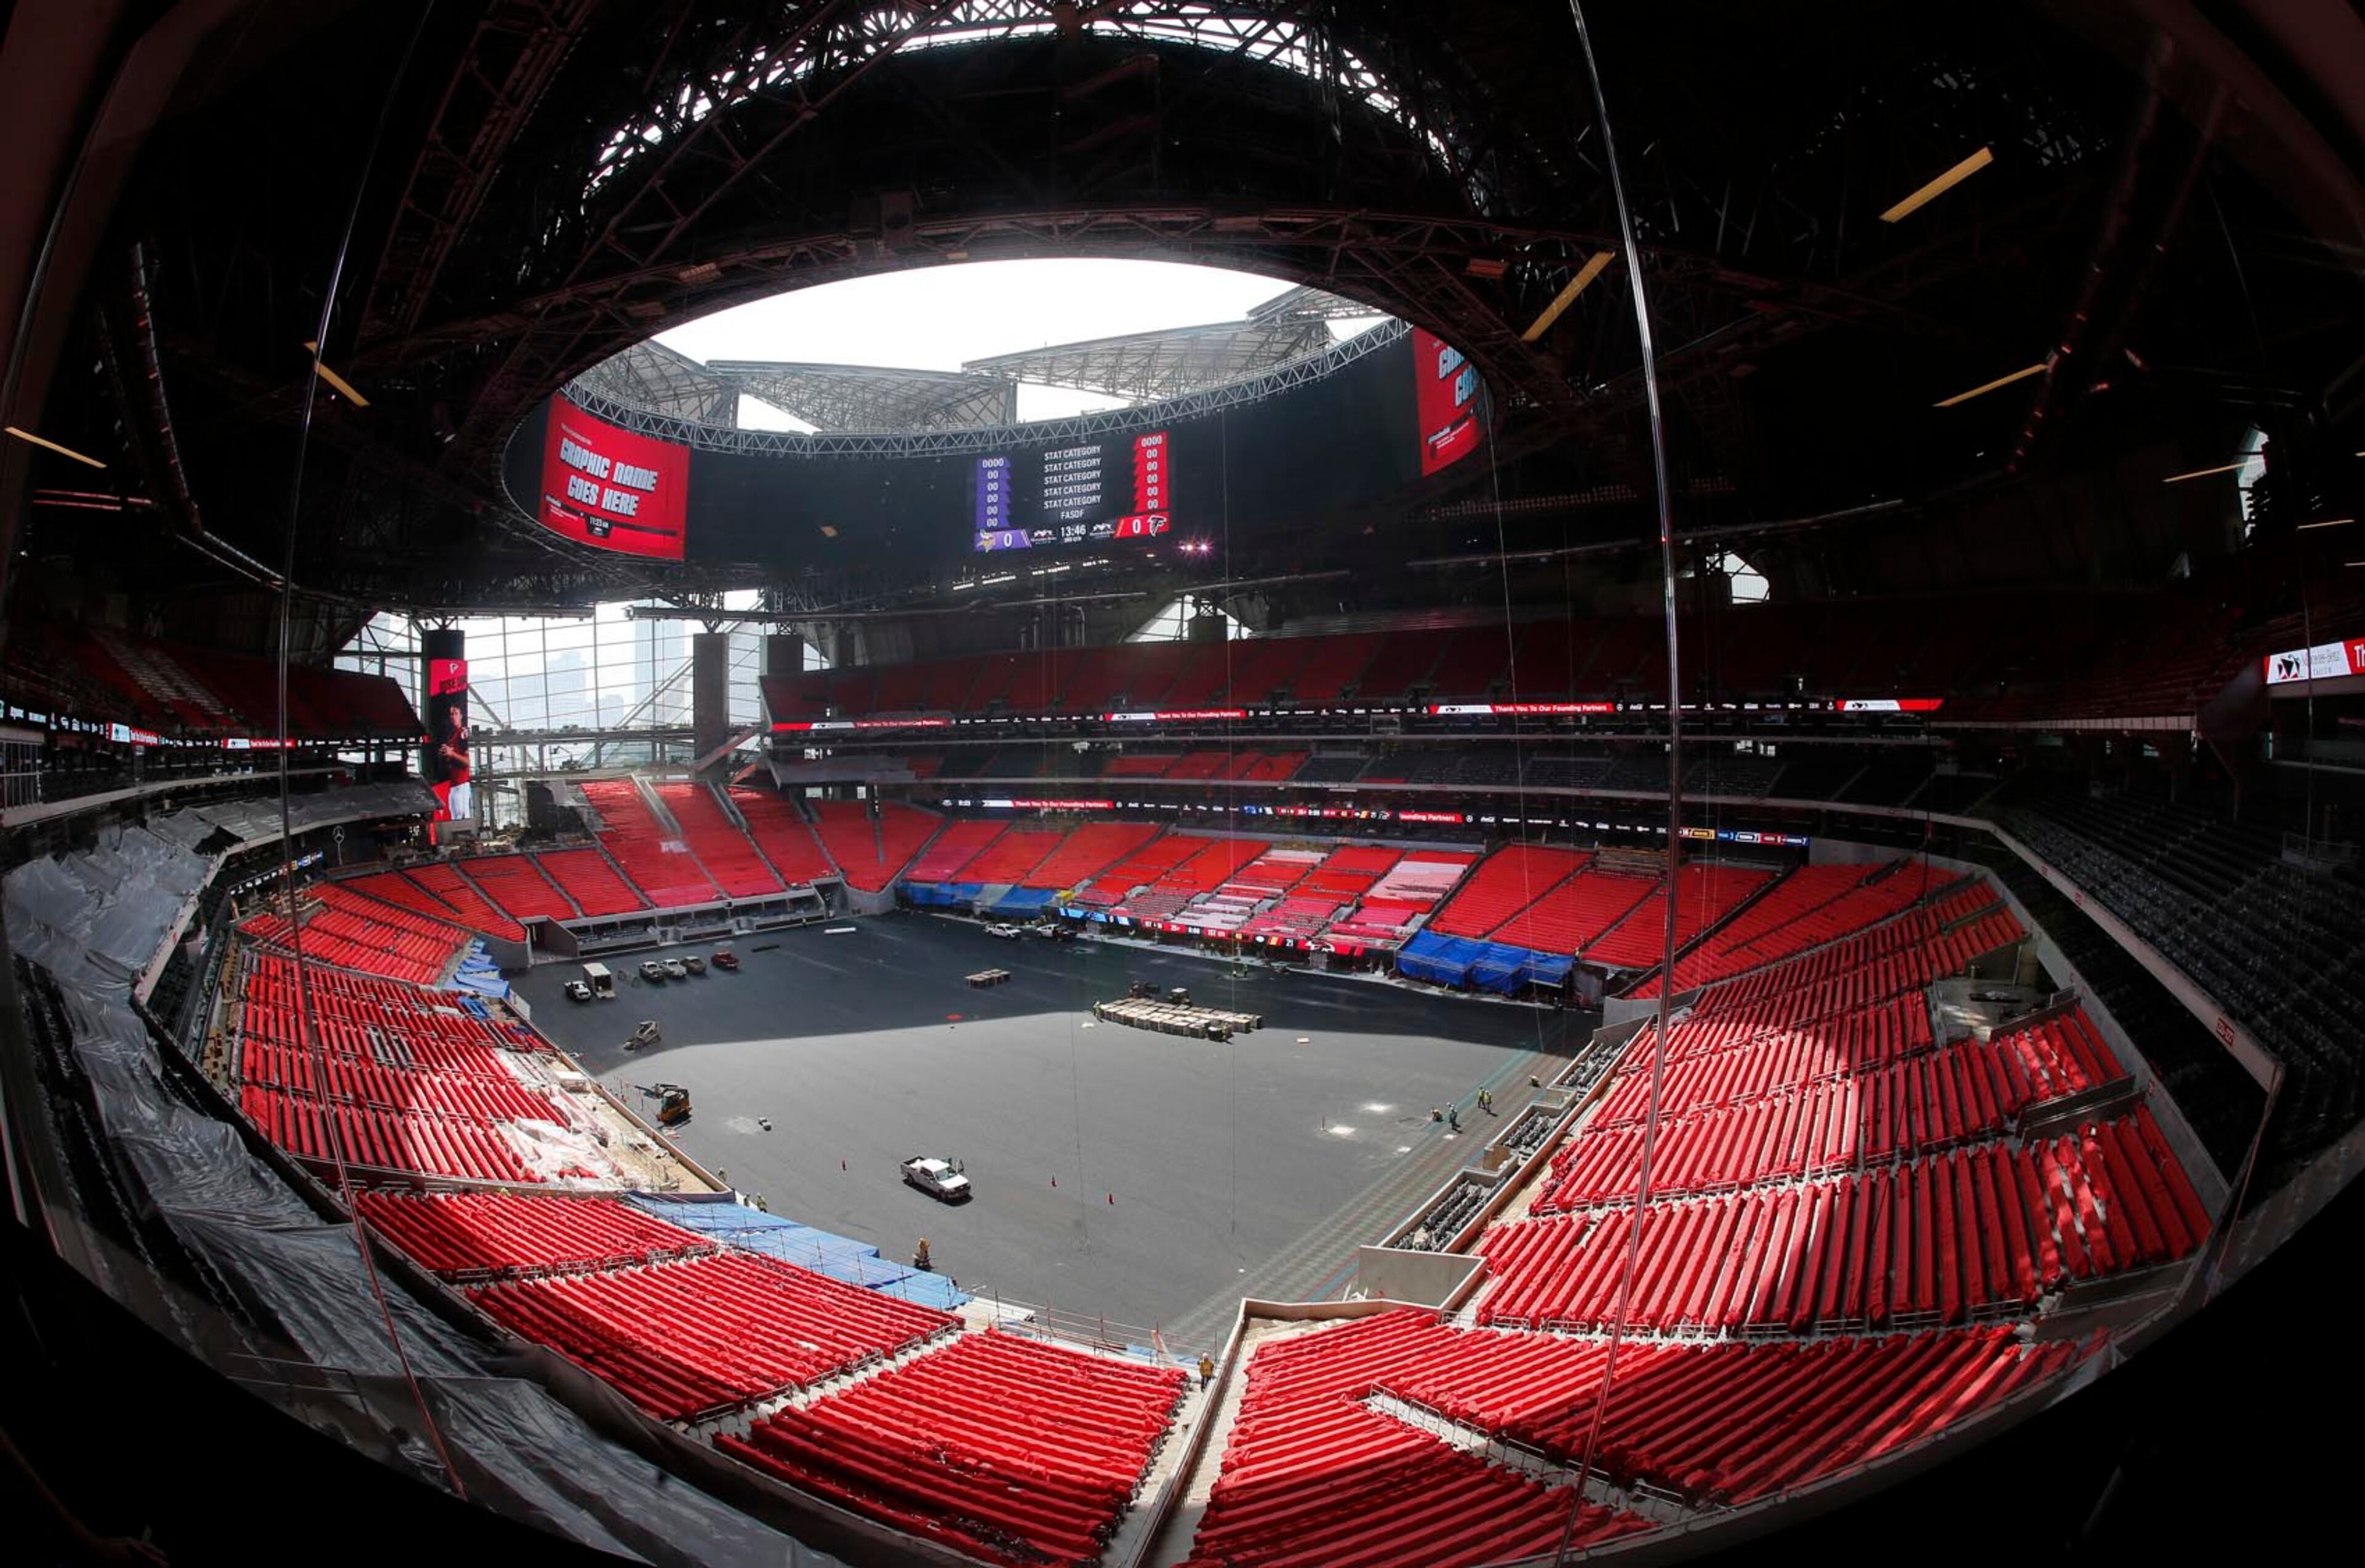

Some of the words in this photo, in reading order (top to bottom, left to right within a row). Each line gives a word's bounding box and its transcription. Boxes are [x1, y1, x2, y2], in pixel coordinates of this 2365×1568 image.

[1141, 435, 1162, 447] 0000
[1044, 451, 1062, 461] STAT
[1063, 445, 1102, 458] CATEGORY
[1147, 449, 1157, 459] 00
[559, 437, 611, 480] GRAPHIC
[612, 461, 658, 492] NAME
[982, 458, 1004, 468] 0000
[1044, 463, 1062, 473] STAT
[1063, 458, 1102, 471] CATEGORY
[1147, 461, 1158, 471] 00
[988, 471, 999, 479] 00
[1044, 475, 1062, 485] STAT
[1063, 470, 1102, 483] CATEGORY
[1147, 474, 1158, 483] 00
[987, 482, 999, 491] 00
[1044, 487, 1062, 498] STAT
[1063, 482, 1102, 495] CATEGORY
[1147, 487, 1158, 496] 00
[567, 474, 600, 506] GOES
[601, 488, 640, 517] HERE
[987, 494, 998, 503] 00
[1044, 499, 1062, 510] STAT
[1063, 495, 1102, 507] CATEGORY
[1148, 499, 1158, 509] 00
[987, 506, 998, 515] 00
[987, 518, 998, 527] 00
[1133, 519, 1141, 535] 0
[1061, 523, 1087, 538] 13:46
[1004, 533, 1013, 547] 0
